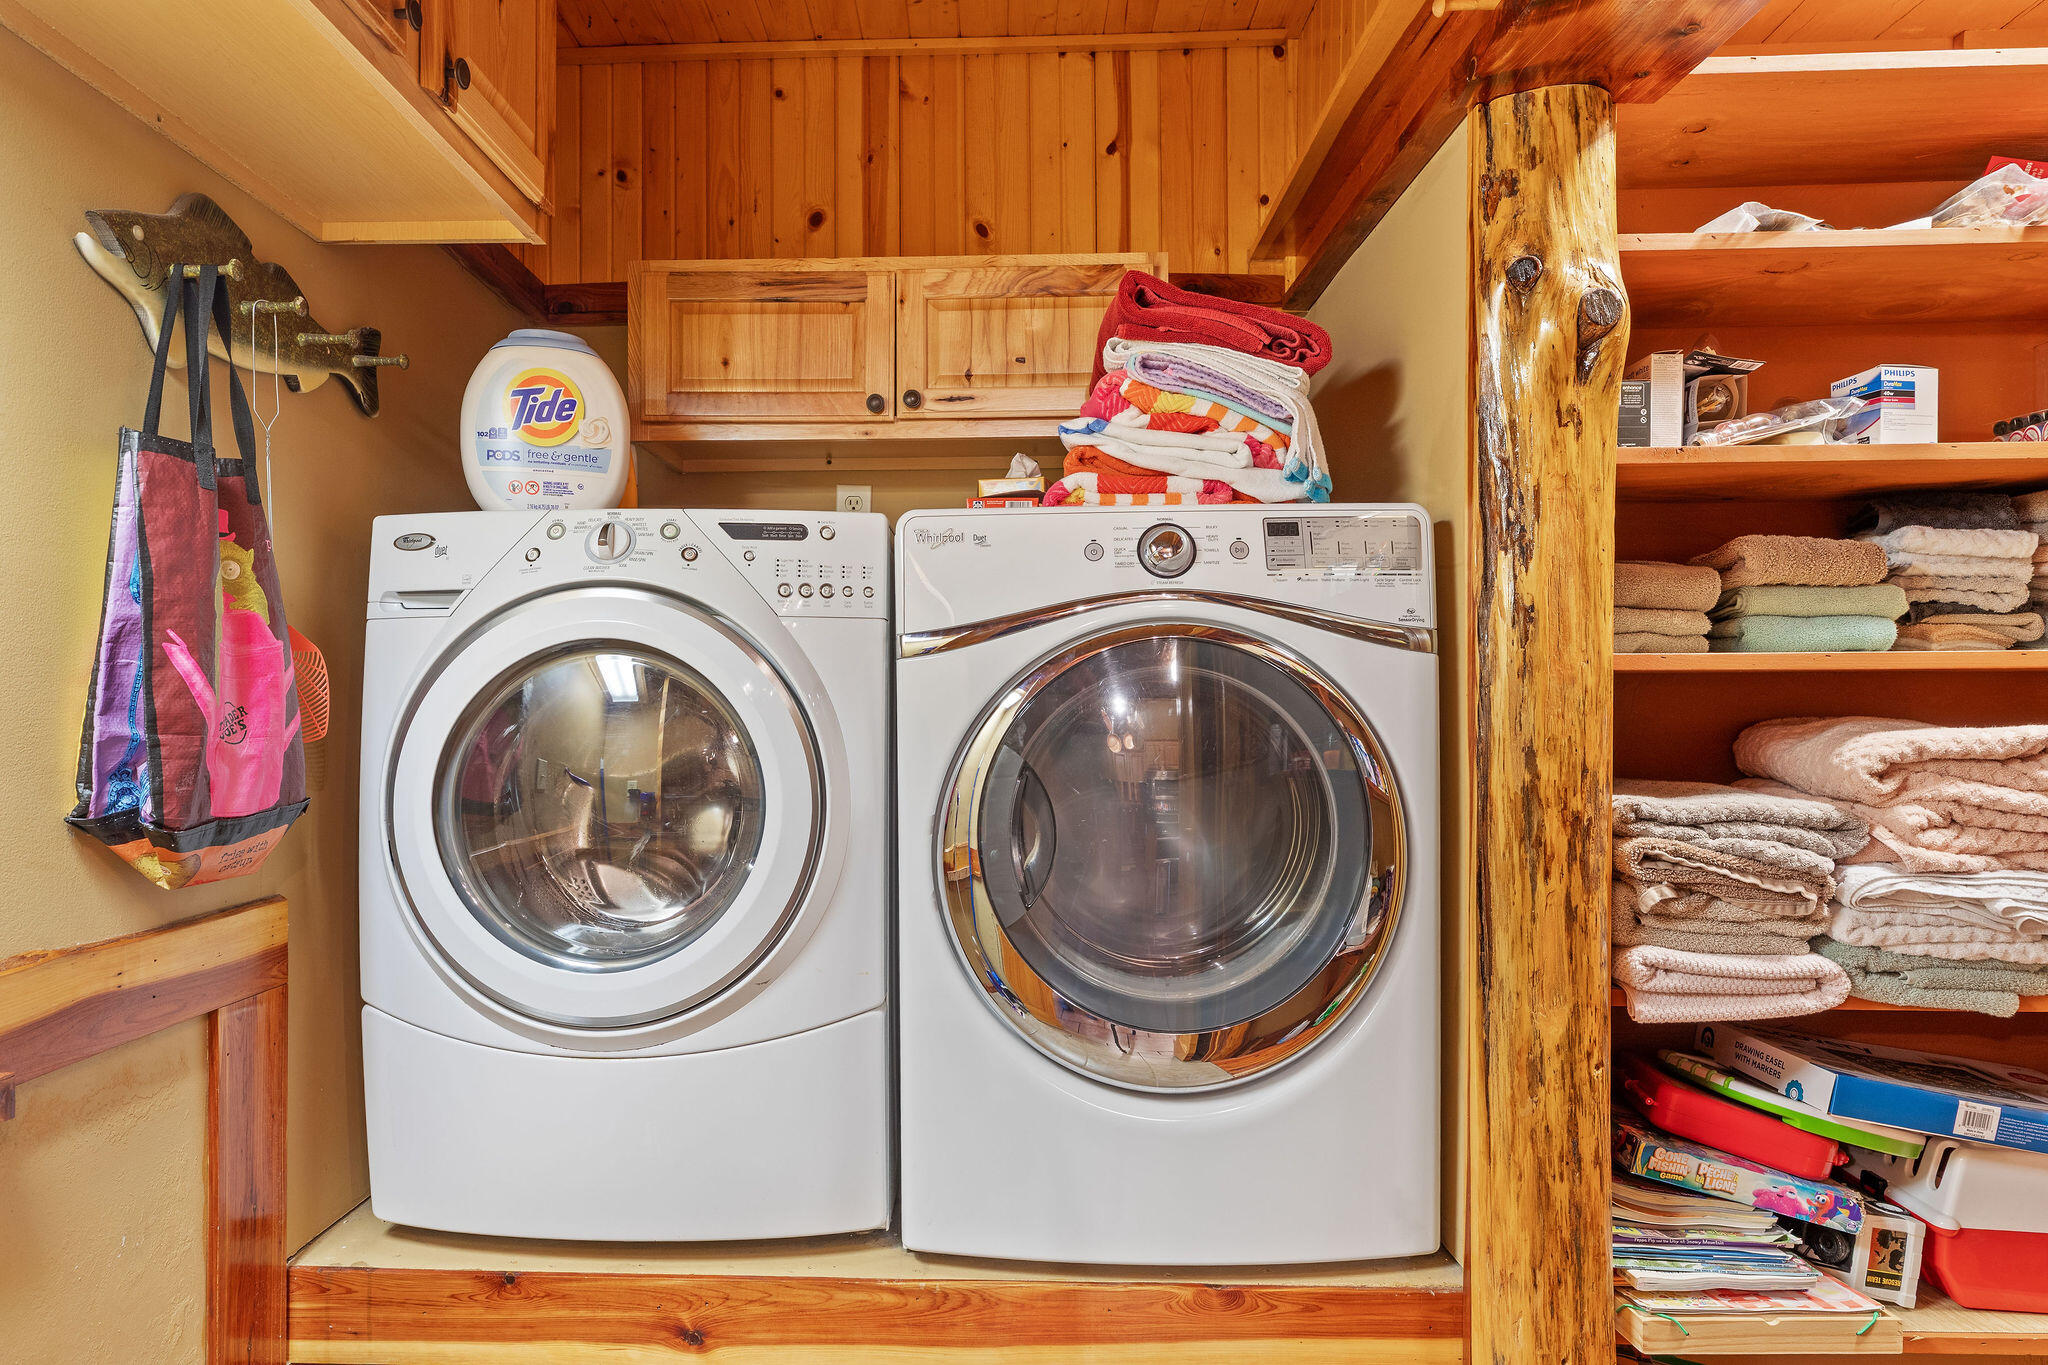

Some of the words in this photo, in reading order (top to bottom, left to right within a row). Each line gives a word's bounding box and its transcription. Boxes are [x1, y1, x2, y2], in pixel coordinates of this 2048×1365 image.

[1884, 369, 1915, 378] PHILIPS
[1831, 377, 1858, 391] PHILIPS
[510, 386, 578, 431] Tide
[486, 449, 521, 461] PODS
[527, 449, 549, 460] free
[551, 451, 563, 461] &
[564, 453, 599, 464] gentle
[915, 532, 964, 544] Whirlpool
[1734, 1040, 1765, 1060] DRAWING
[1765, 1054, 1785, 1070] EASEL
[1735, 1052, 1751, 1066] WITH
[1751, 1059, 1781, 1079] MARKERS
[1653, 1146, 1689, 1164] GONE
[1659, 1171, 1684, 1181] Game
[1704, 1176, 1738, 1194] LIGNE
[1866, 1275, 1881, 1284] TEAM
[1881, 1277, 1901, 1287] RESCUE
